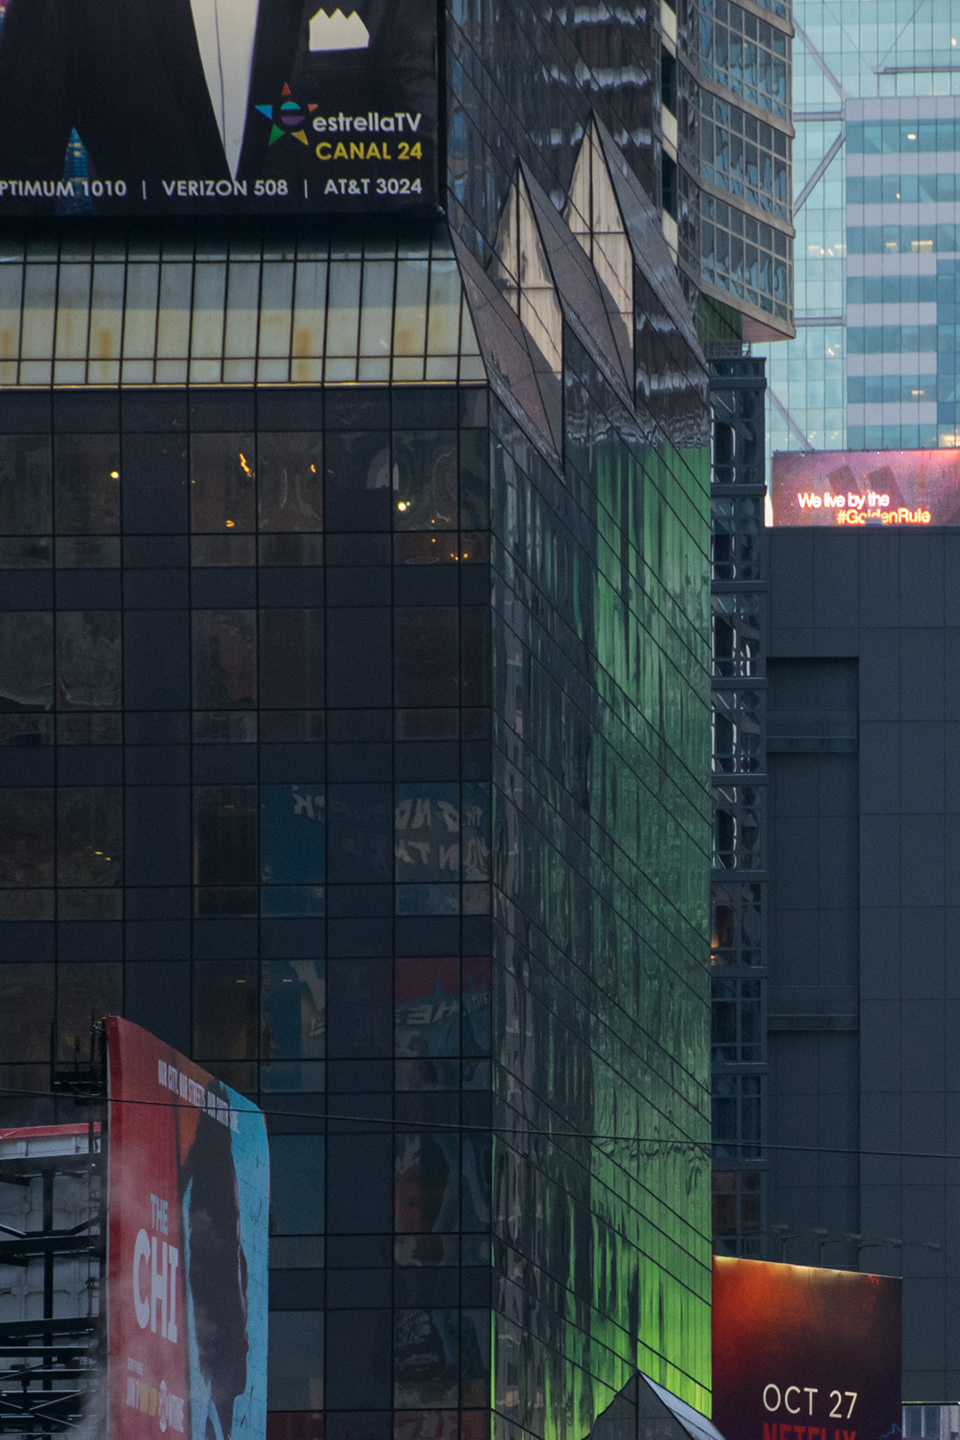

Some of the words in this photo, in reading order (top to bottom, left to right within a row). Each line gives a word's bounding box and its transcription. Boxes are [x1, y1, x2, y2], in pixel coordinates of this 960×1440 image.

[312, 113, 422, 132] estrellaTV
[315, 142, 393, 160] CANAL
[397, 142, 423, 160] 24
[81, 180, 127, 196] 1010
[162, 179, 248, 196] VERIZON
[253, 179, 289, 196] 508
[324, 178, 371, 194] AT&T
[375, 178, 423, 194] 3024
[797, 492, 821, 509] We
[824, 491, 846, 508] live
[848, 491, 866, 510] by
[868, 491, 890, 507] the
[150, 1192, 170, 1235] THE
[132, 1228, 180, 1345] CHI
[762, 1383, 818, 1417] OCT
[828, 1390, 858, 1420] 27
